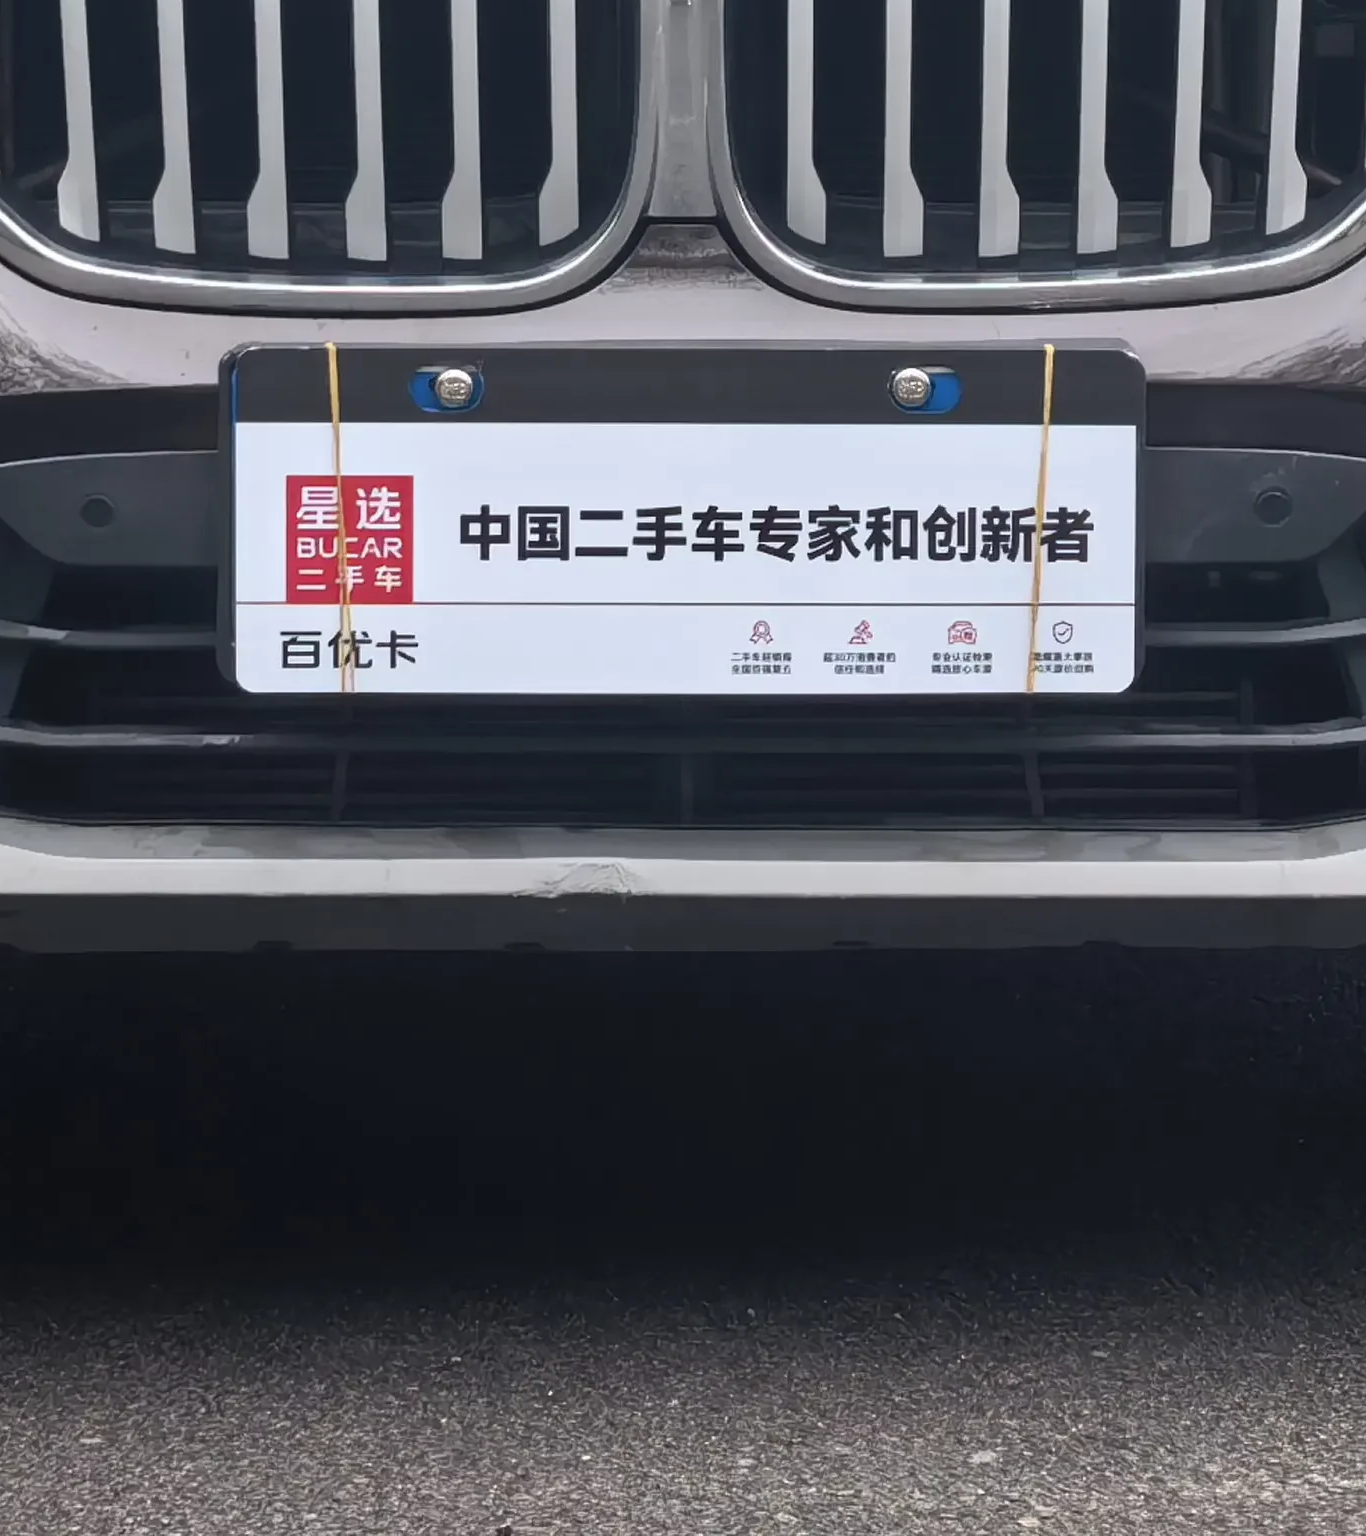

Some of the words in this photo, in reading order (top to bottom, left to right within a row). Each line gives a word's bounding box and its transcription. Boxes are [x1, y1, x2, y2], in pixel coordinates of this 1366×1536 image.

[296, 485, 402, 530] 星选
[296, 537, 403, 559] BUCAR
[459, 504, 1095, 563] 中国二手车专家和创新者
[296, 565, 402, 593] 二手车
[280, 629, 419, 669] 百优卡
